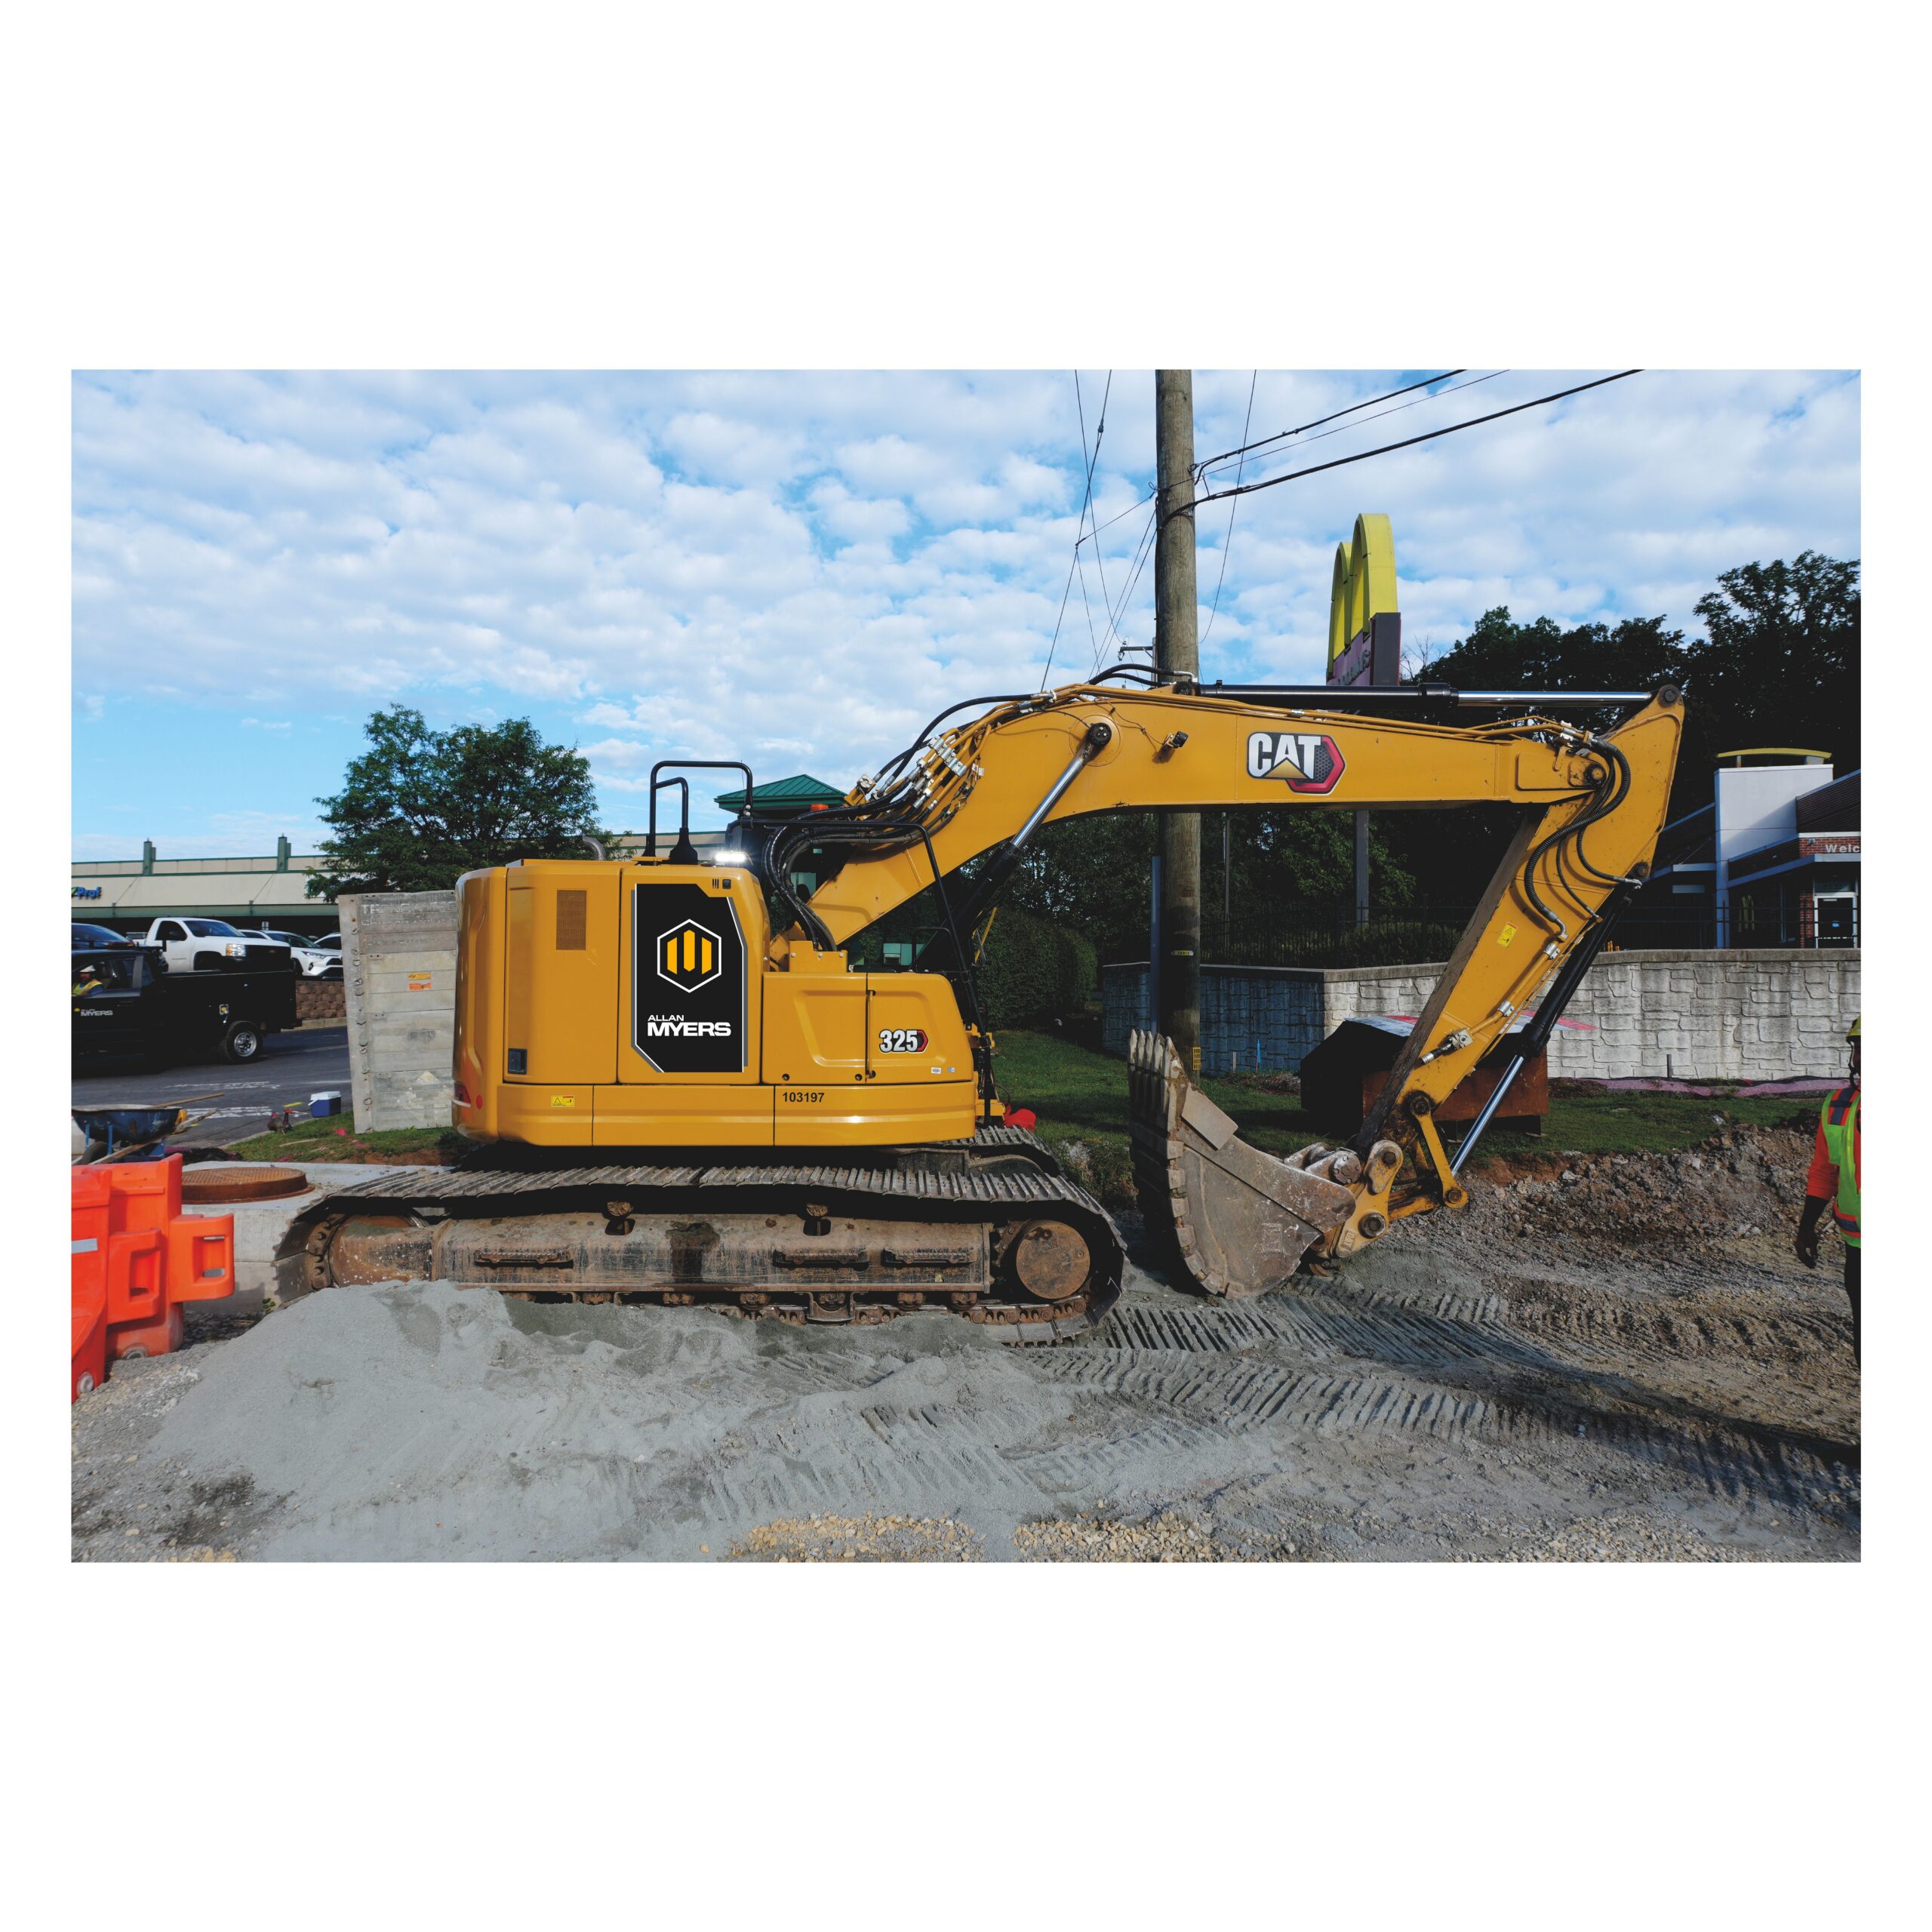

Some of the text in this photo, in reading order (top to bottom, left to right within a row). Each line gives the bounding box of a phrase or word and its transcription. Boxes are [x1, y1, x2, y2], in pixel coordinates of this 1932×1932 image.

[1248, 733, 1321, 780] CAT
[1826, 844, 1860, 853] Welc
[648, 1022, 731, 1036] MYERS
[879, 1029, 918, 1053] 325
[783, 1092, 825, 1103] 103197
